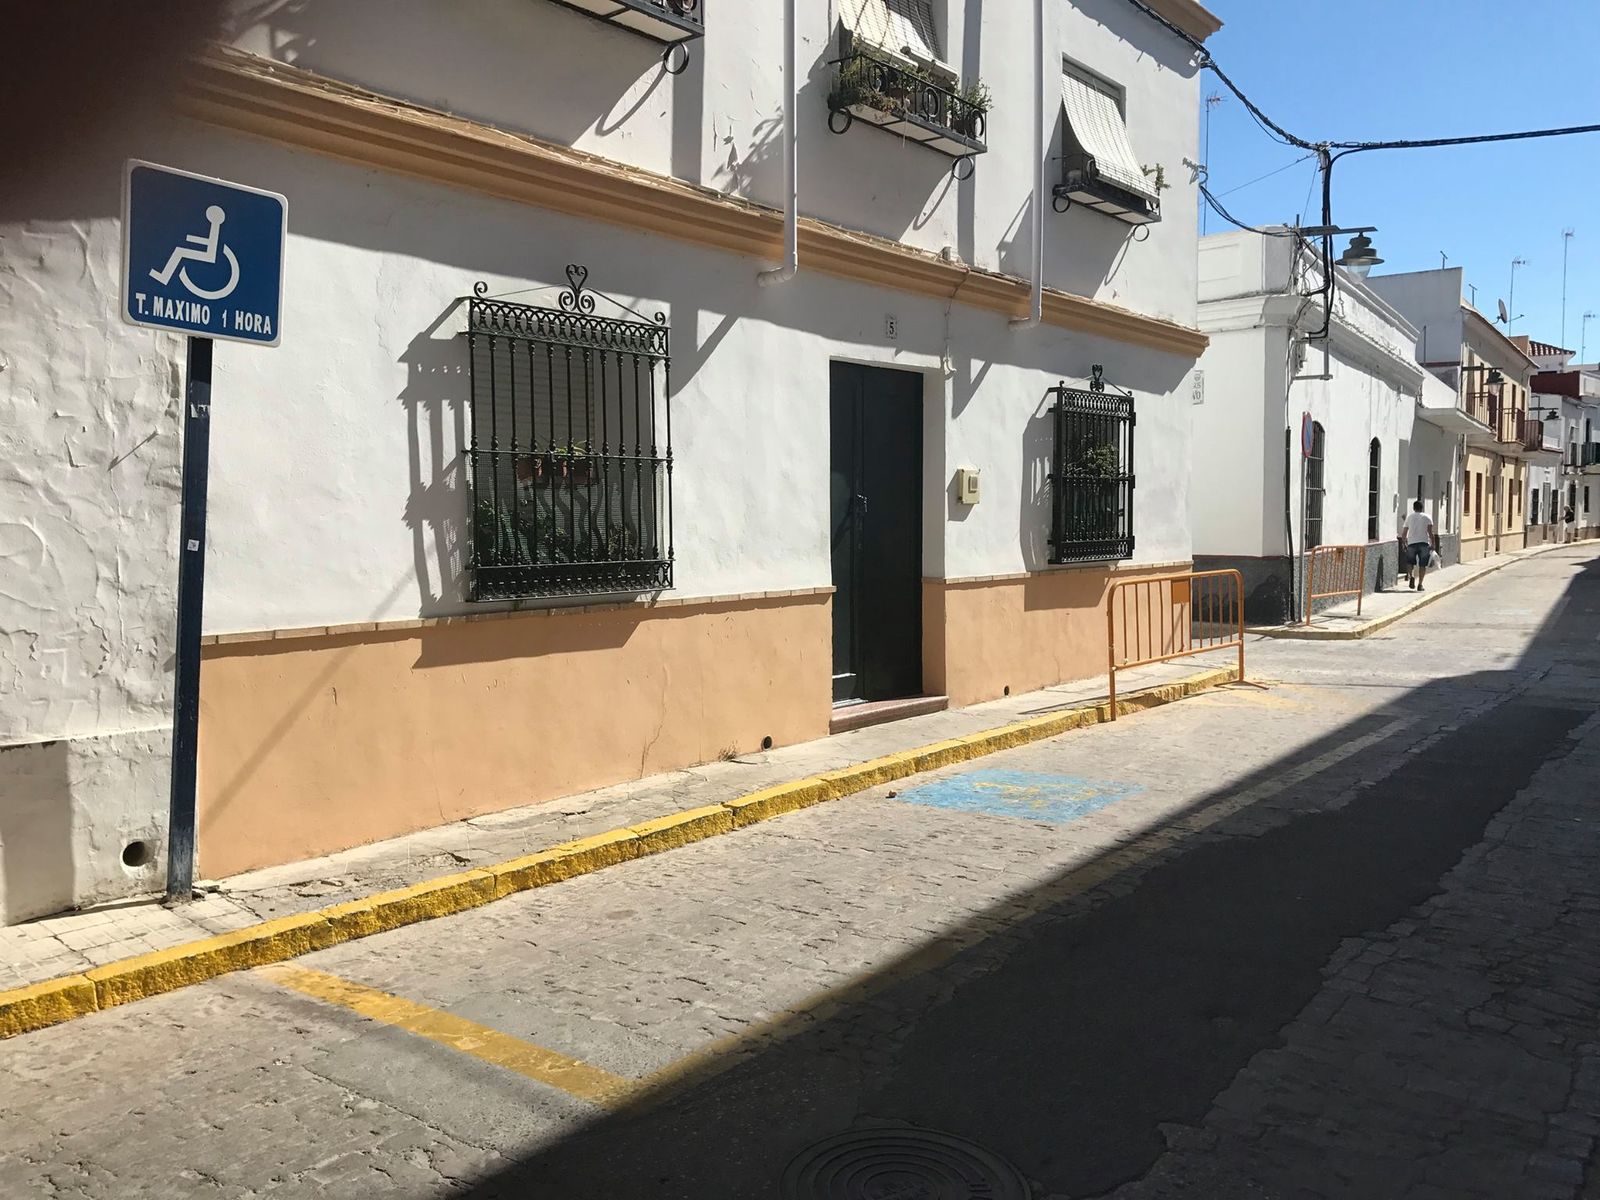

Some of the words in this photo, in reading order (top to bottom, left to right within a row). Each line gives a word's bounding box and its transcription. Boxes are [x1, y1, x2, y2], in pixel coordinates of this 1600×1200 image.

[136, 293, 149, 315] T.
[153, 296, 211, 326] MAXIMO
[222, 309, 228, 328] 1
[234, 310, 272, 335] HORA
